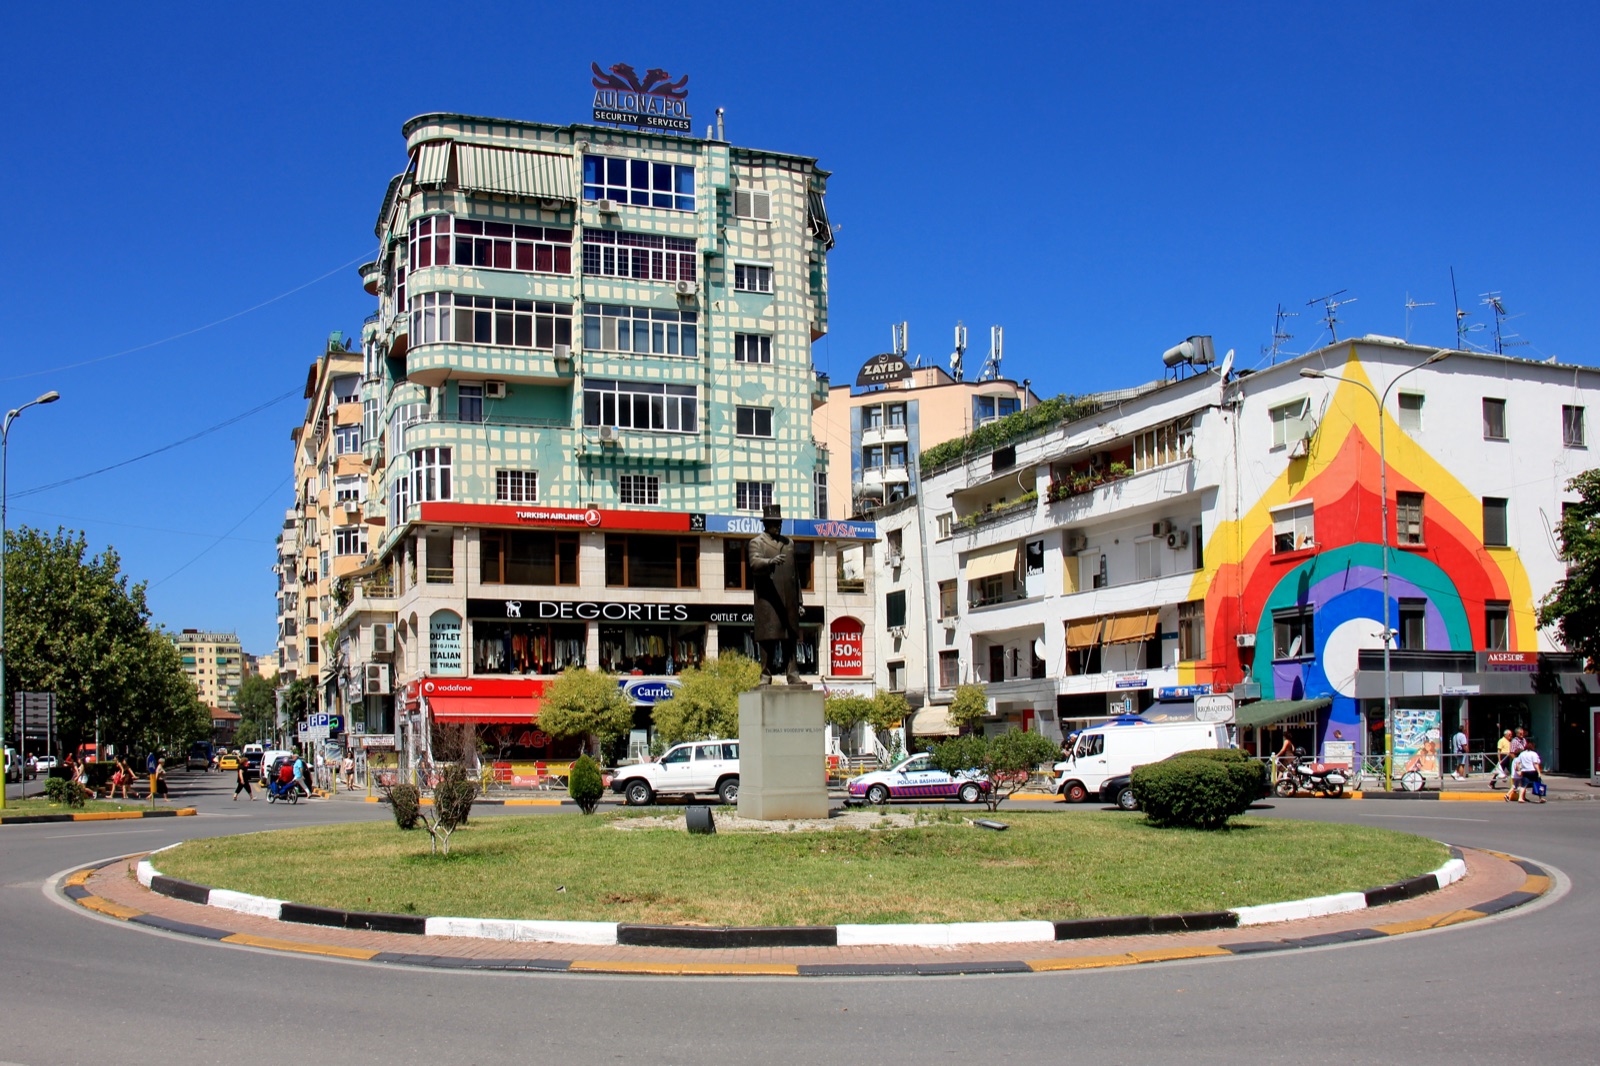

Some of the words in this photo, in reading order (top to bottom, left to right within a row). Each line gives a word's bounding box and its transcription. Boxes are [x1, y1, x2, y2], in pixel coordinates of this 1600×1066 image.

[593, 90, 662, 115] AULONA
[664, 98, 692, 118] POL
[595, 111, 638, 123] SECURITY
[647, 117, 689, 129] SERVICES
[864, 361, 904, 376] ZAYED
[871, 373, 898, 381] CENTER
[516, 511, 550, 520] TURKISH
[550, 513, 585, 521] AIRLINES
[728, 517, 766, 534] SIGM
[814, 521, 856, 538] VJOSA
[539, 601, 688, 621] DEGORTES
[710, 613, 738, 622] OUTLET
[741, 613, 755, 622] GR
[430, 633, 461, 641] OUTLET
[830, 632, 862, 641] OUTLET
[430, 652, 461, 660] ITALIAN
[832, 660, 862, 668] TALIANO
[438, 684, 473, 692] vodafone
[637, 686, 673, 697] Carrier
[319, 715, 327, 724] P
[519, 730, 552, 748] 4G+
